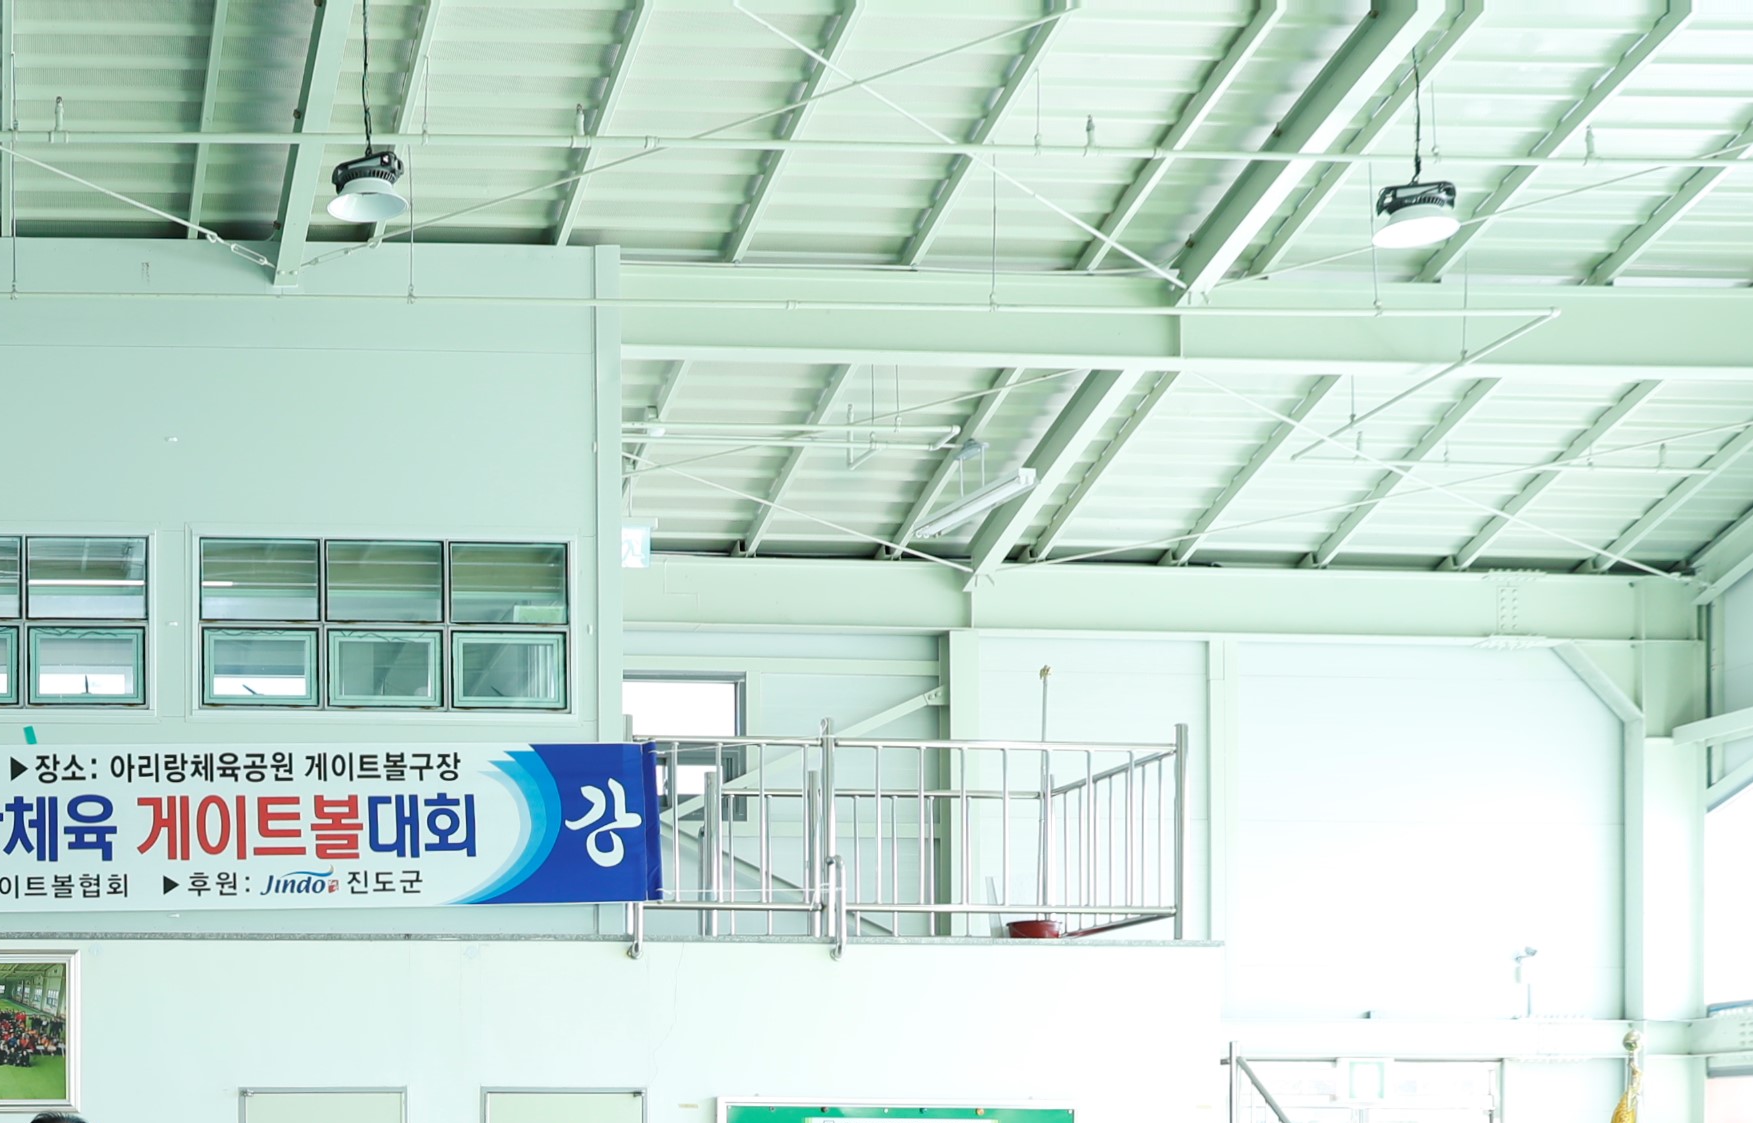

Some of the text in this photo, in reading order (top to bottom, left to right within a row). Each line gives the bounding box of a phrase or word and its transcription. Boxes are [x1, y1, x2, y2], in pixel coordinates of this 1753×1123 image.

[35, 752, 461, 784] 장소: 아리랑체육공원 게이트볼구장
[137, 793, 476, 861] 게이트볼대회
[565, 778, 642, 868] 강
[188, 870, 423, 897] 후원: Jindo 진도군
